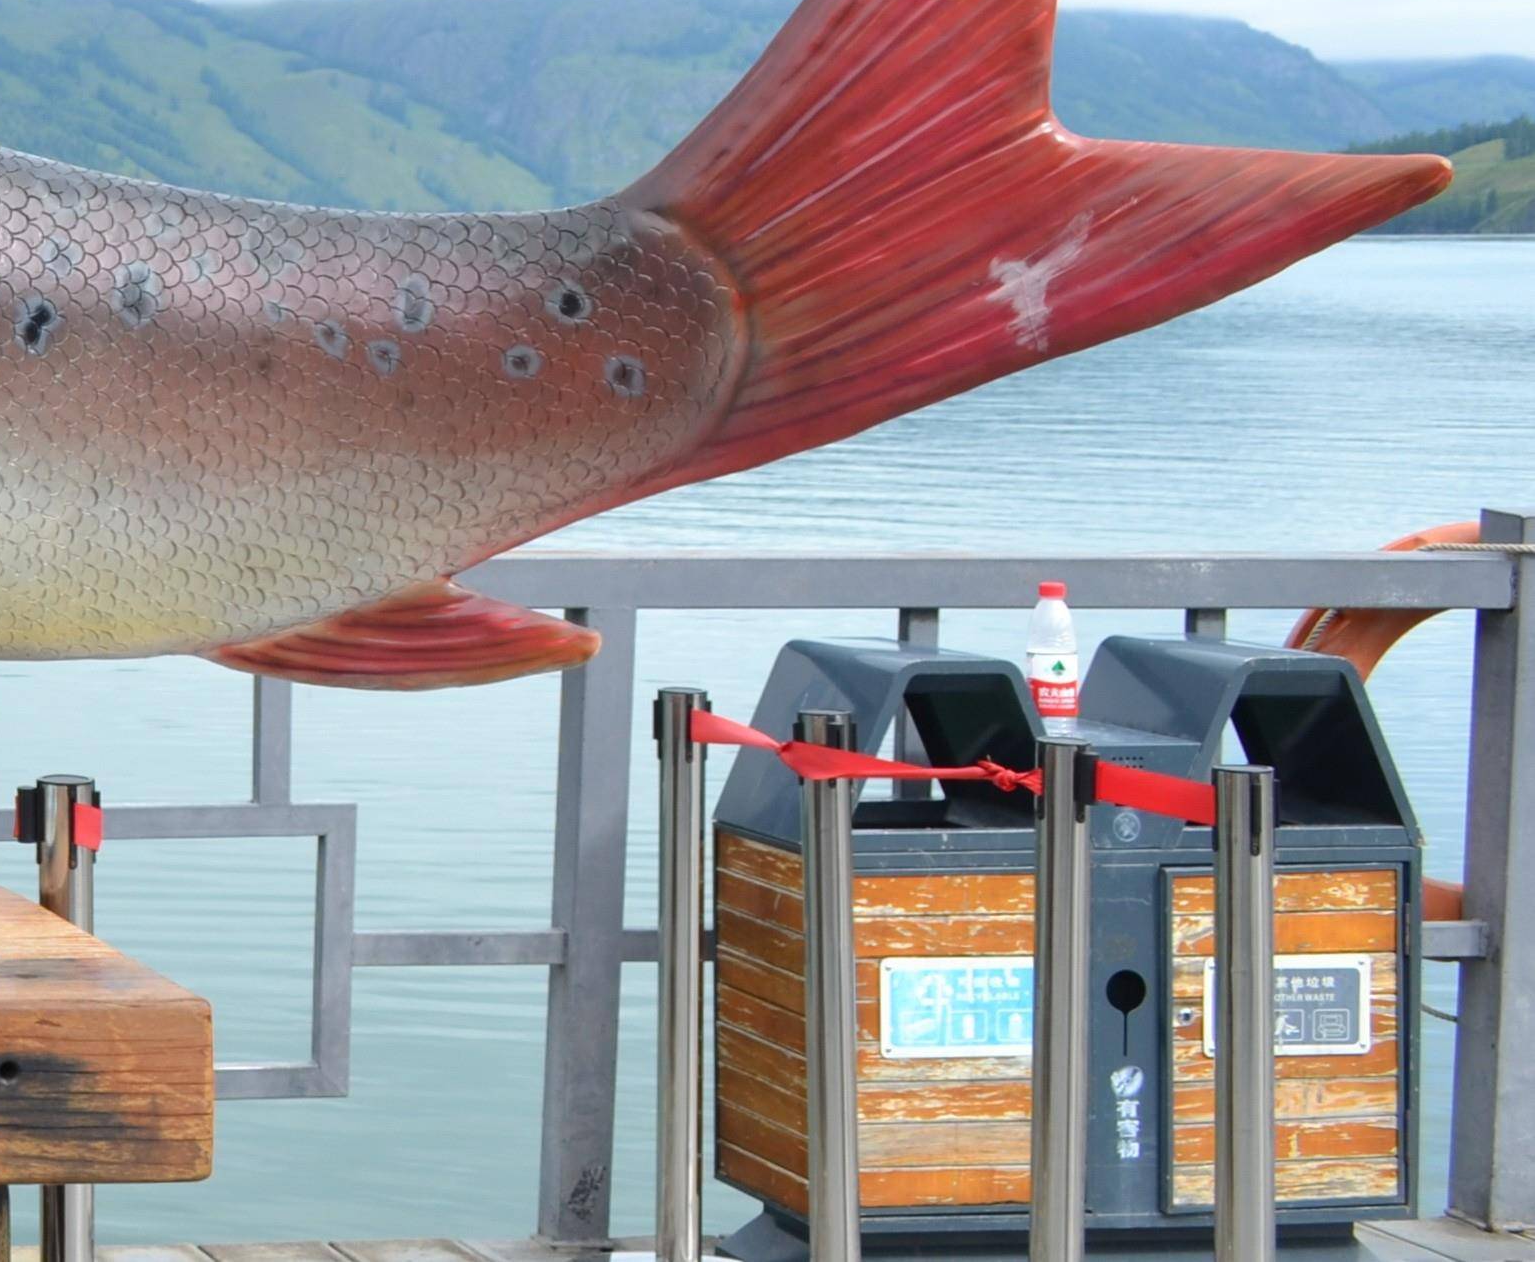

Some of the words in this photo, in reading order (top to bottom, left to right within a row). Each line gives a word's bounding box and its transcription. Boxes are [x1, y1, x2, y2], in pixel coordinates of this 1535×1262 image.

[1275, 976, 1335, 989] 其他垃圾
[1274, 993, 1303, 1002] OTHER
[1304, 993, 1335, 1002] WASTE
